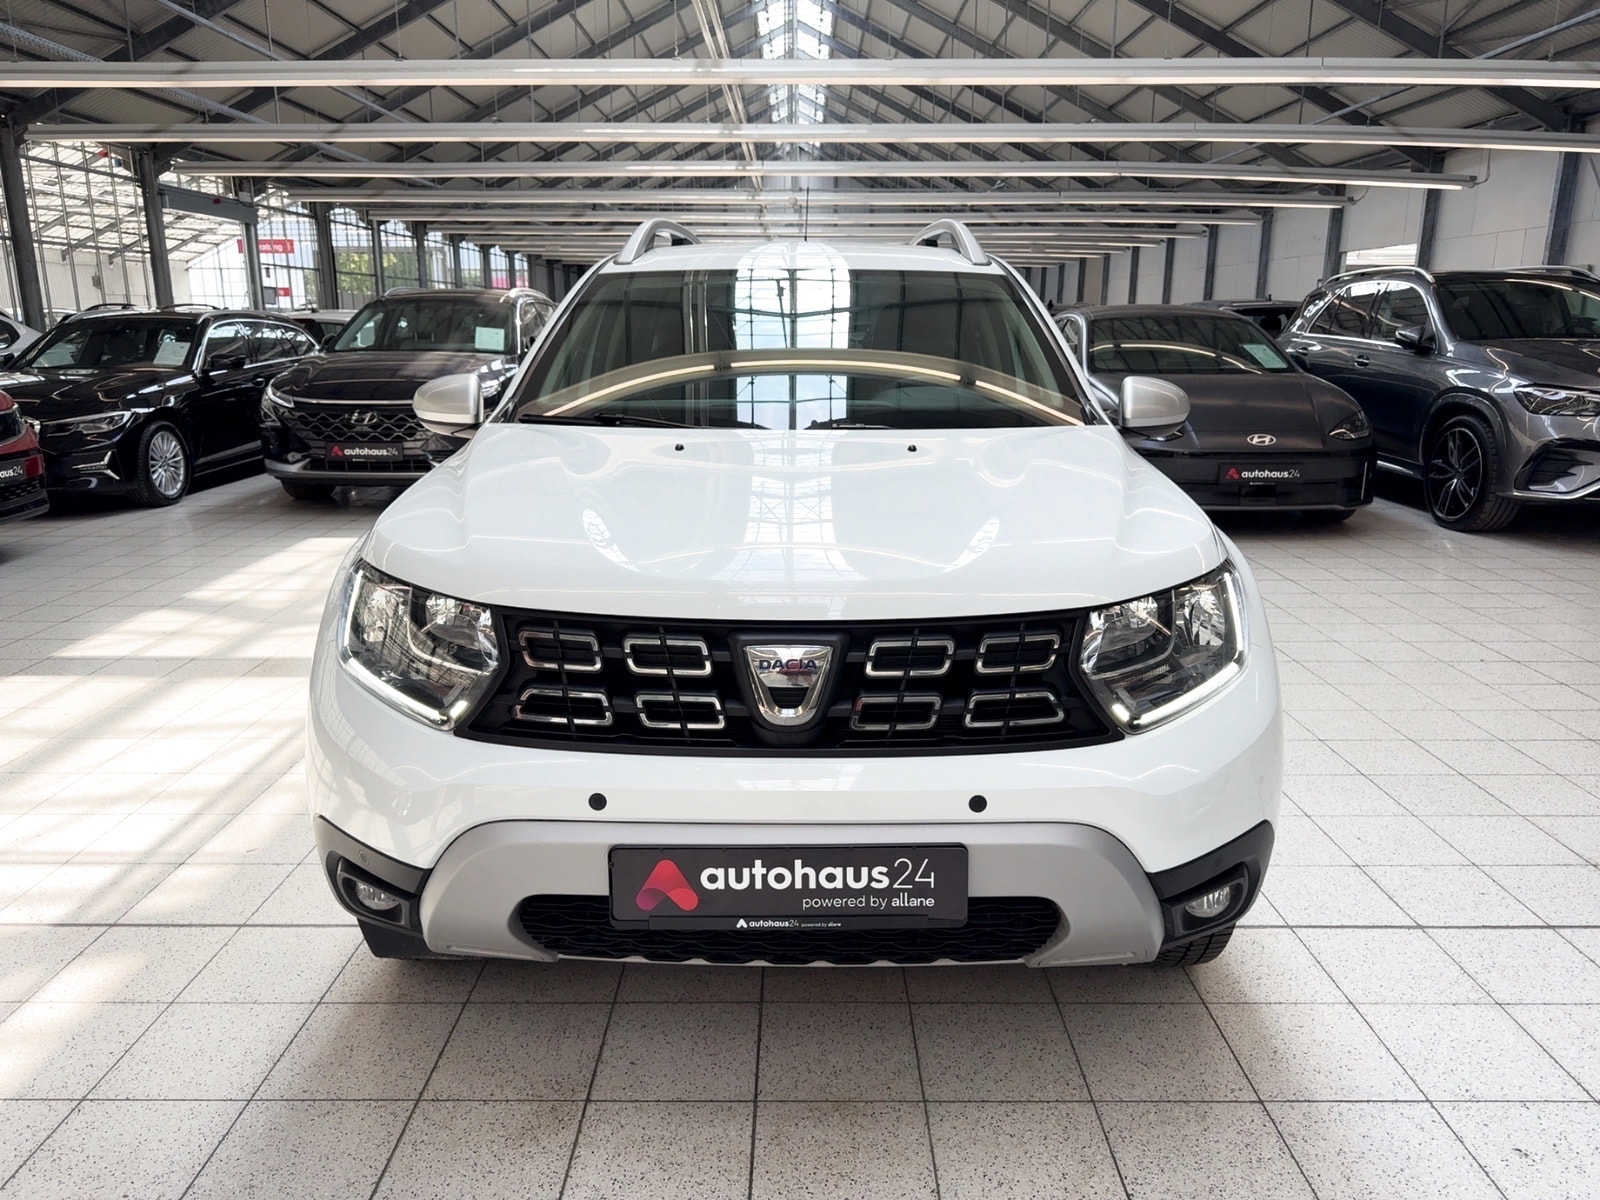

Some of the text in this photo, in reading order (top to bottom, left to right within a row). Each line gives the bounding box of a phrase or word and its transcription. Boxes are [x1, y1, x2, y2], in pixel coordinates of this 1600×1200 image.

[343, 447, 398, 456] autohaus24
[0, 465, 23, 478] aus24
[1241, 469, 1300, 478] autohaus24
[758, 659, 817, 670] DACIA
[700, 858, 935, 890] autohaus24
[802, 892, 935, 910] powered by allane
[749, 919, 799, 928] autohaus24
